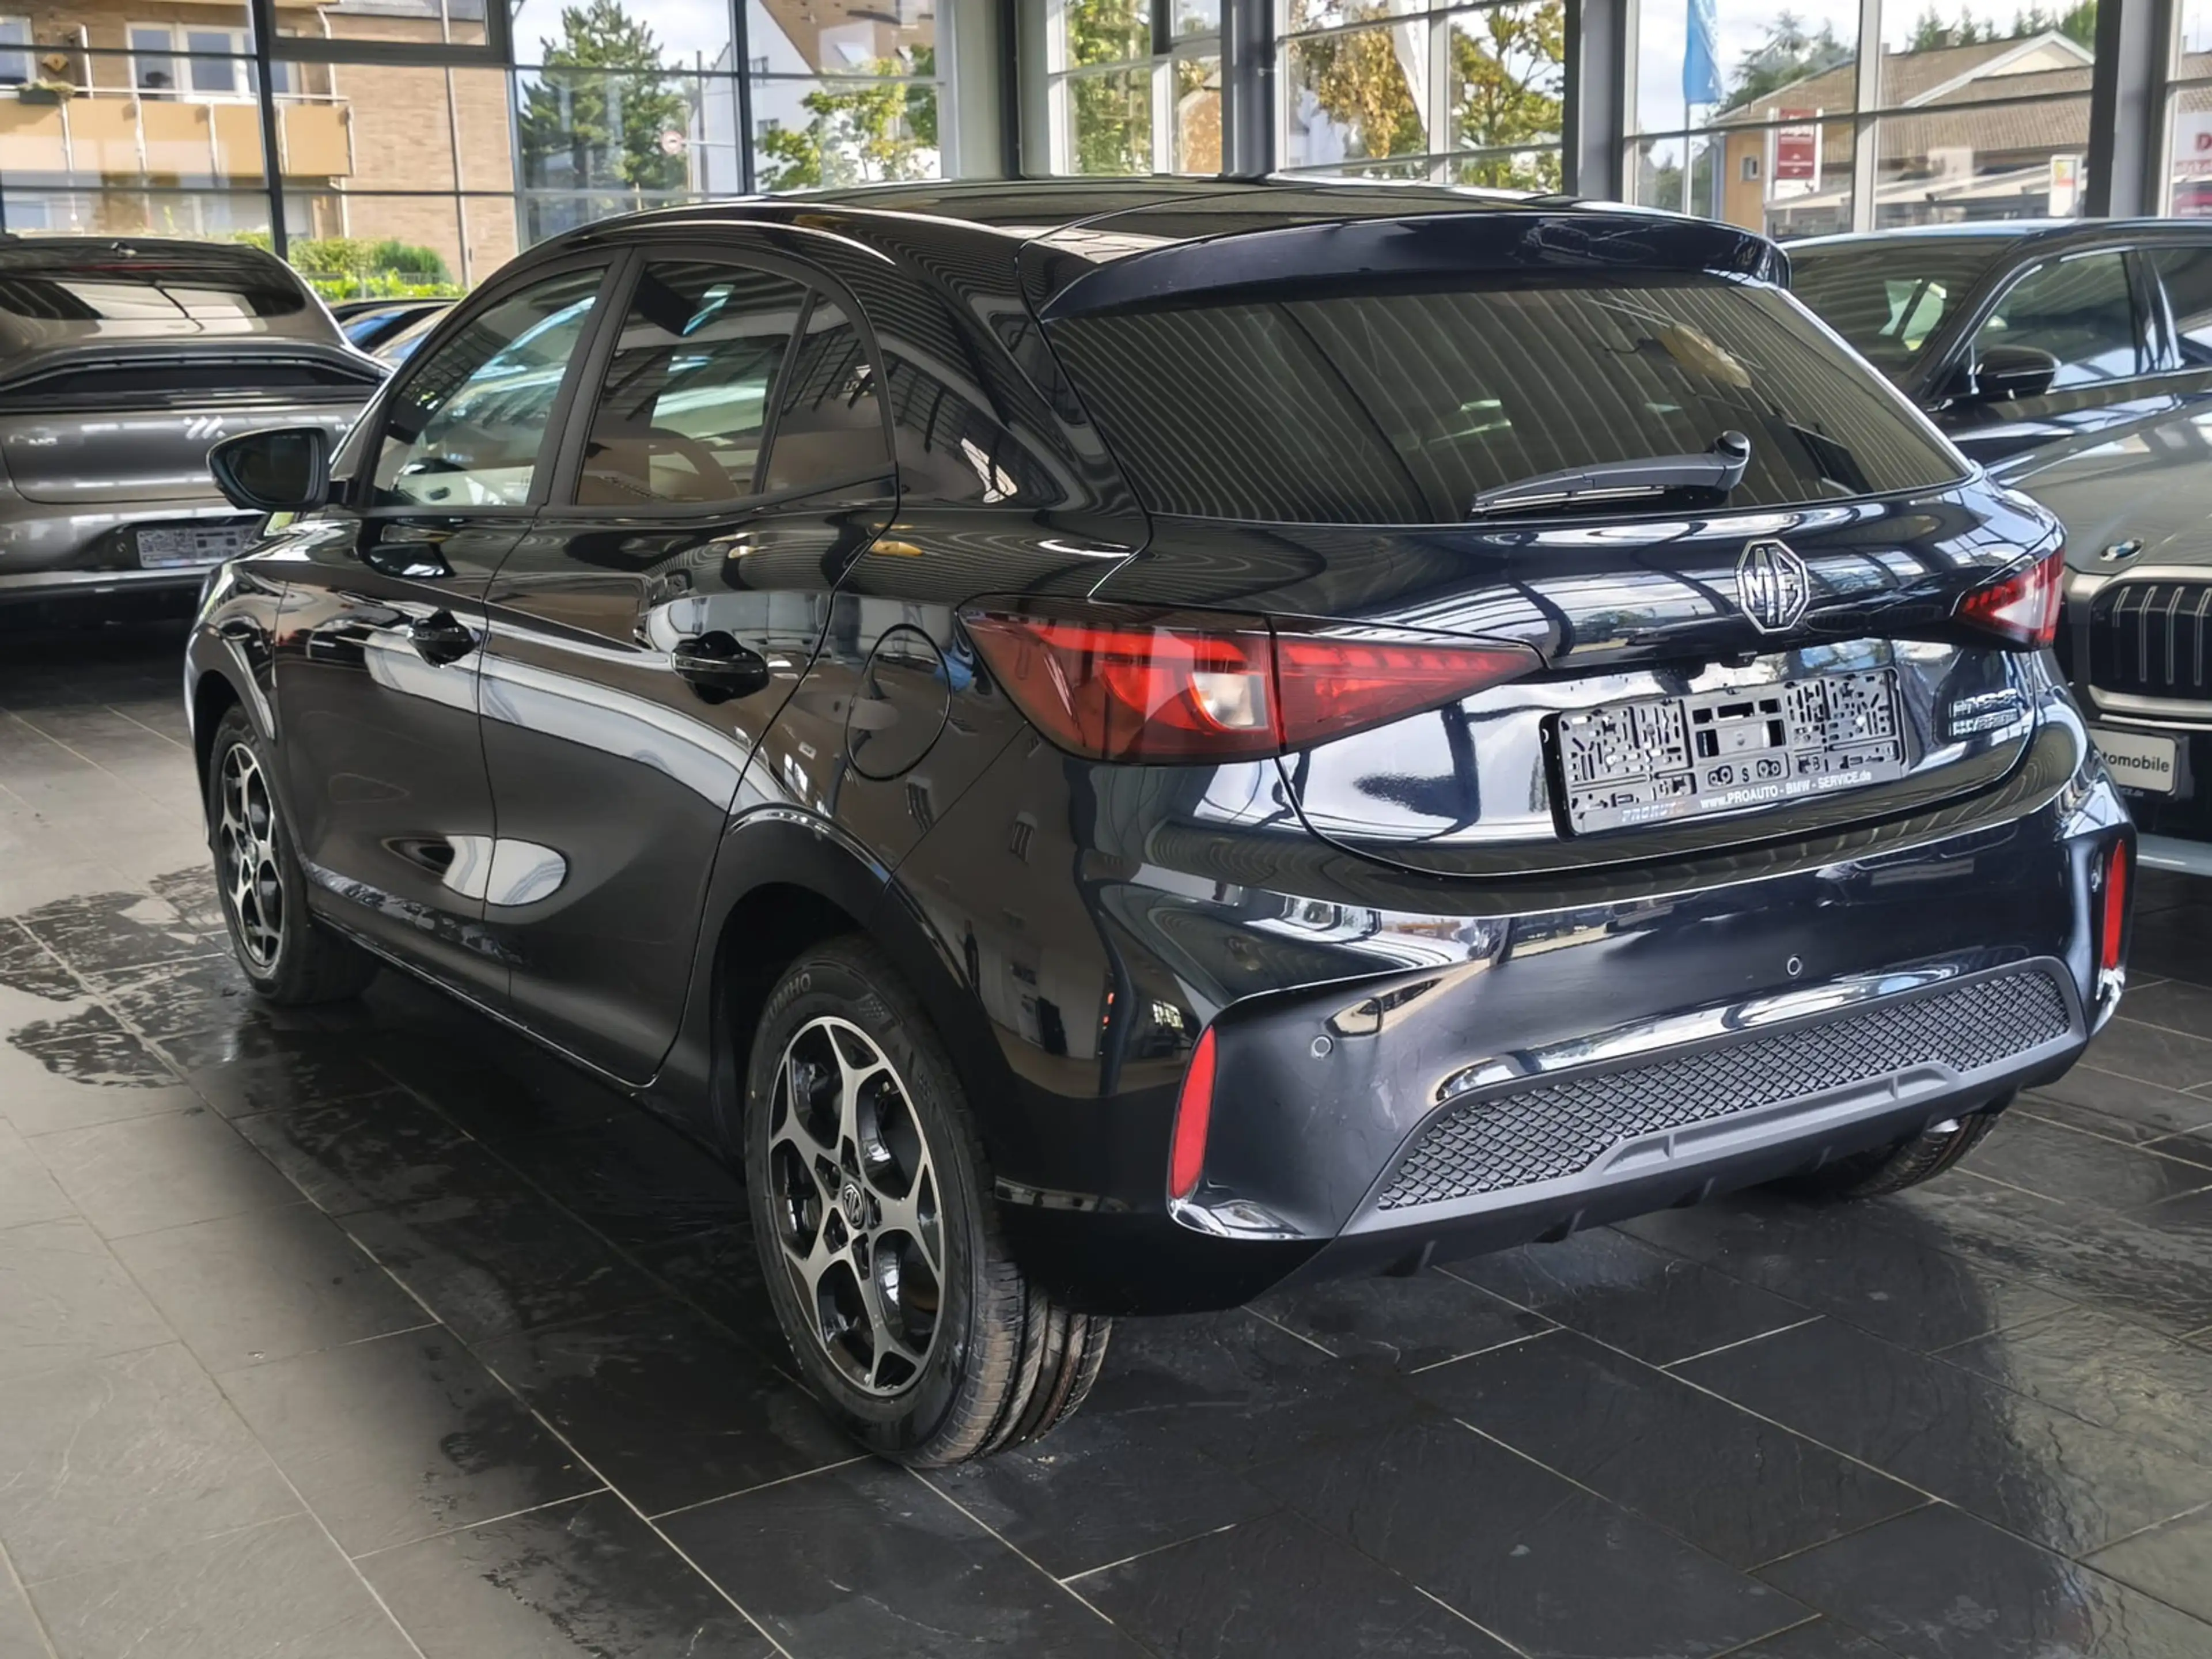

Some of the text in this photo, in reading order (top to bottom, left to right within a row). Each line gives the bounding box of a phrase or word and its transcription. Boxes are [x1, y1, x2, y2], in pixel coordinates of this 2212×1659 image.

[1743, 547, 1804, 624] MG
[1785, 779, 1810, 795] BMW
[762, 973, 811, 1029] UMHO
